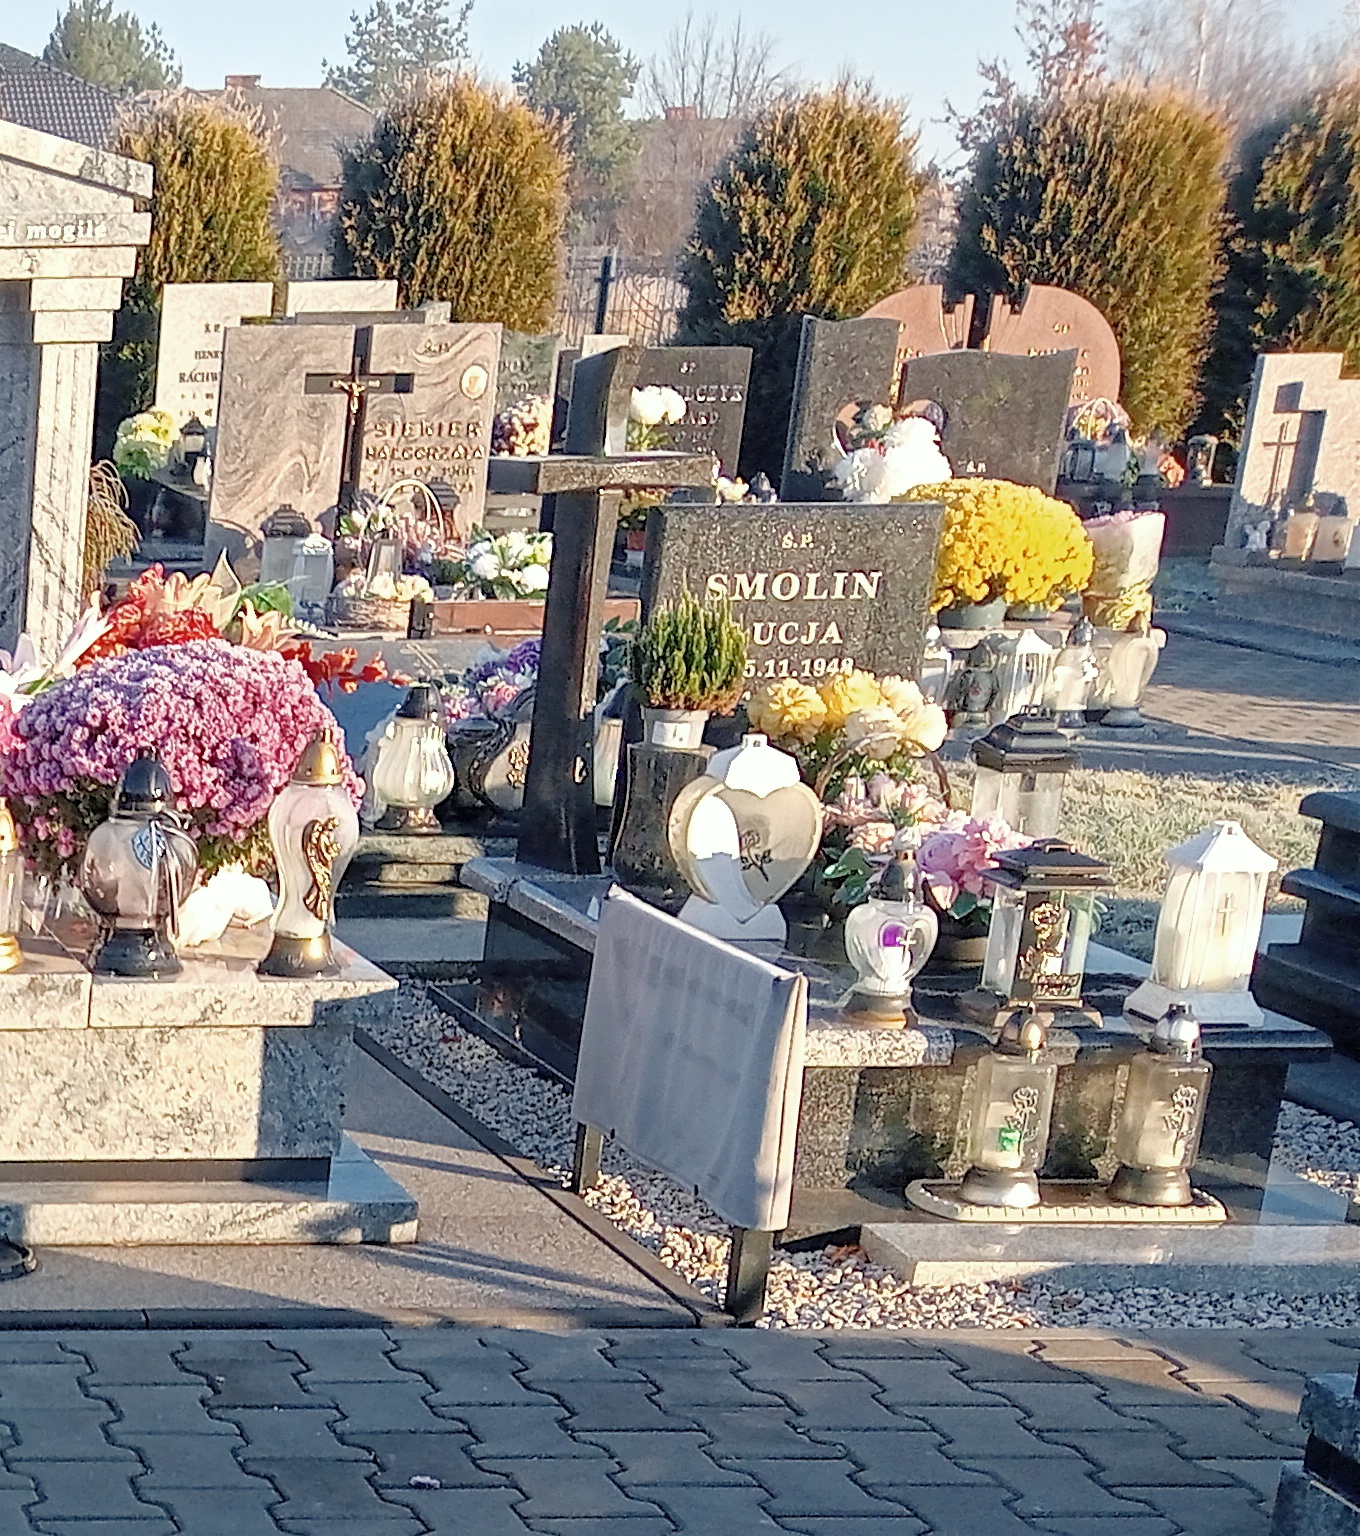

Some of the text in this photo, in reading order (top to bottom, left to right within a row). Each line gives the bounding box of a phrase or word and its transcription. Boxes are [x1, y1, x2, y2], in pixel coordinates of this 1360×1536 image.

[26, 220, 107, 243] mogile
[707, 571, 883, 600] SMOLIN
[753, 622, 843, 645] UCJA
